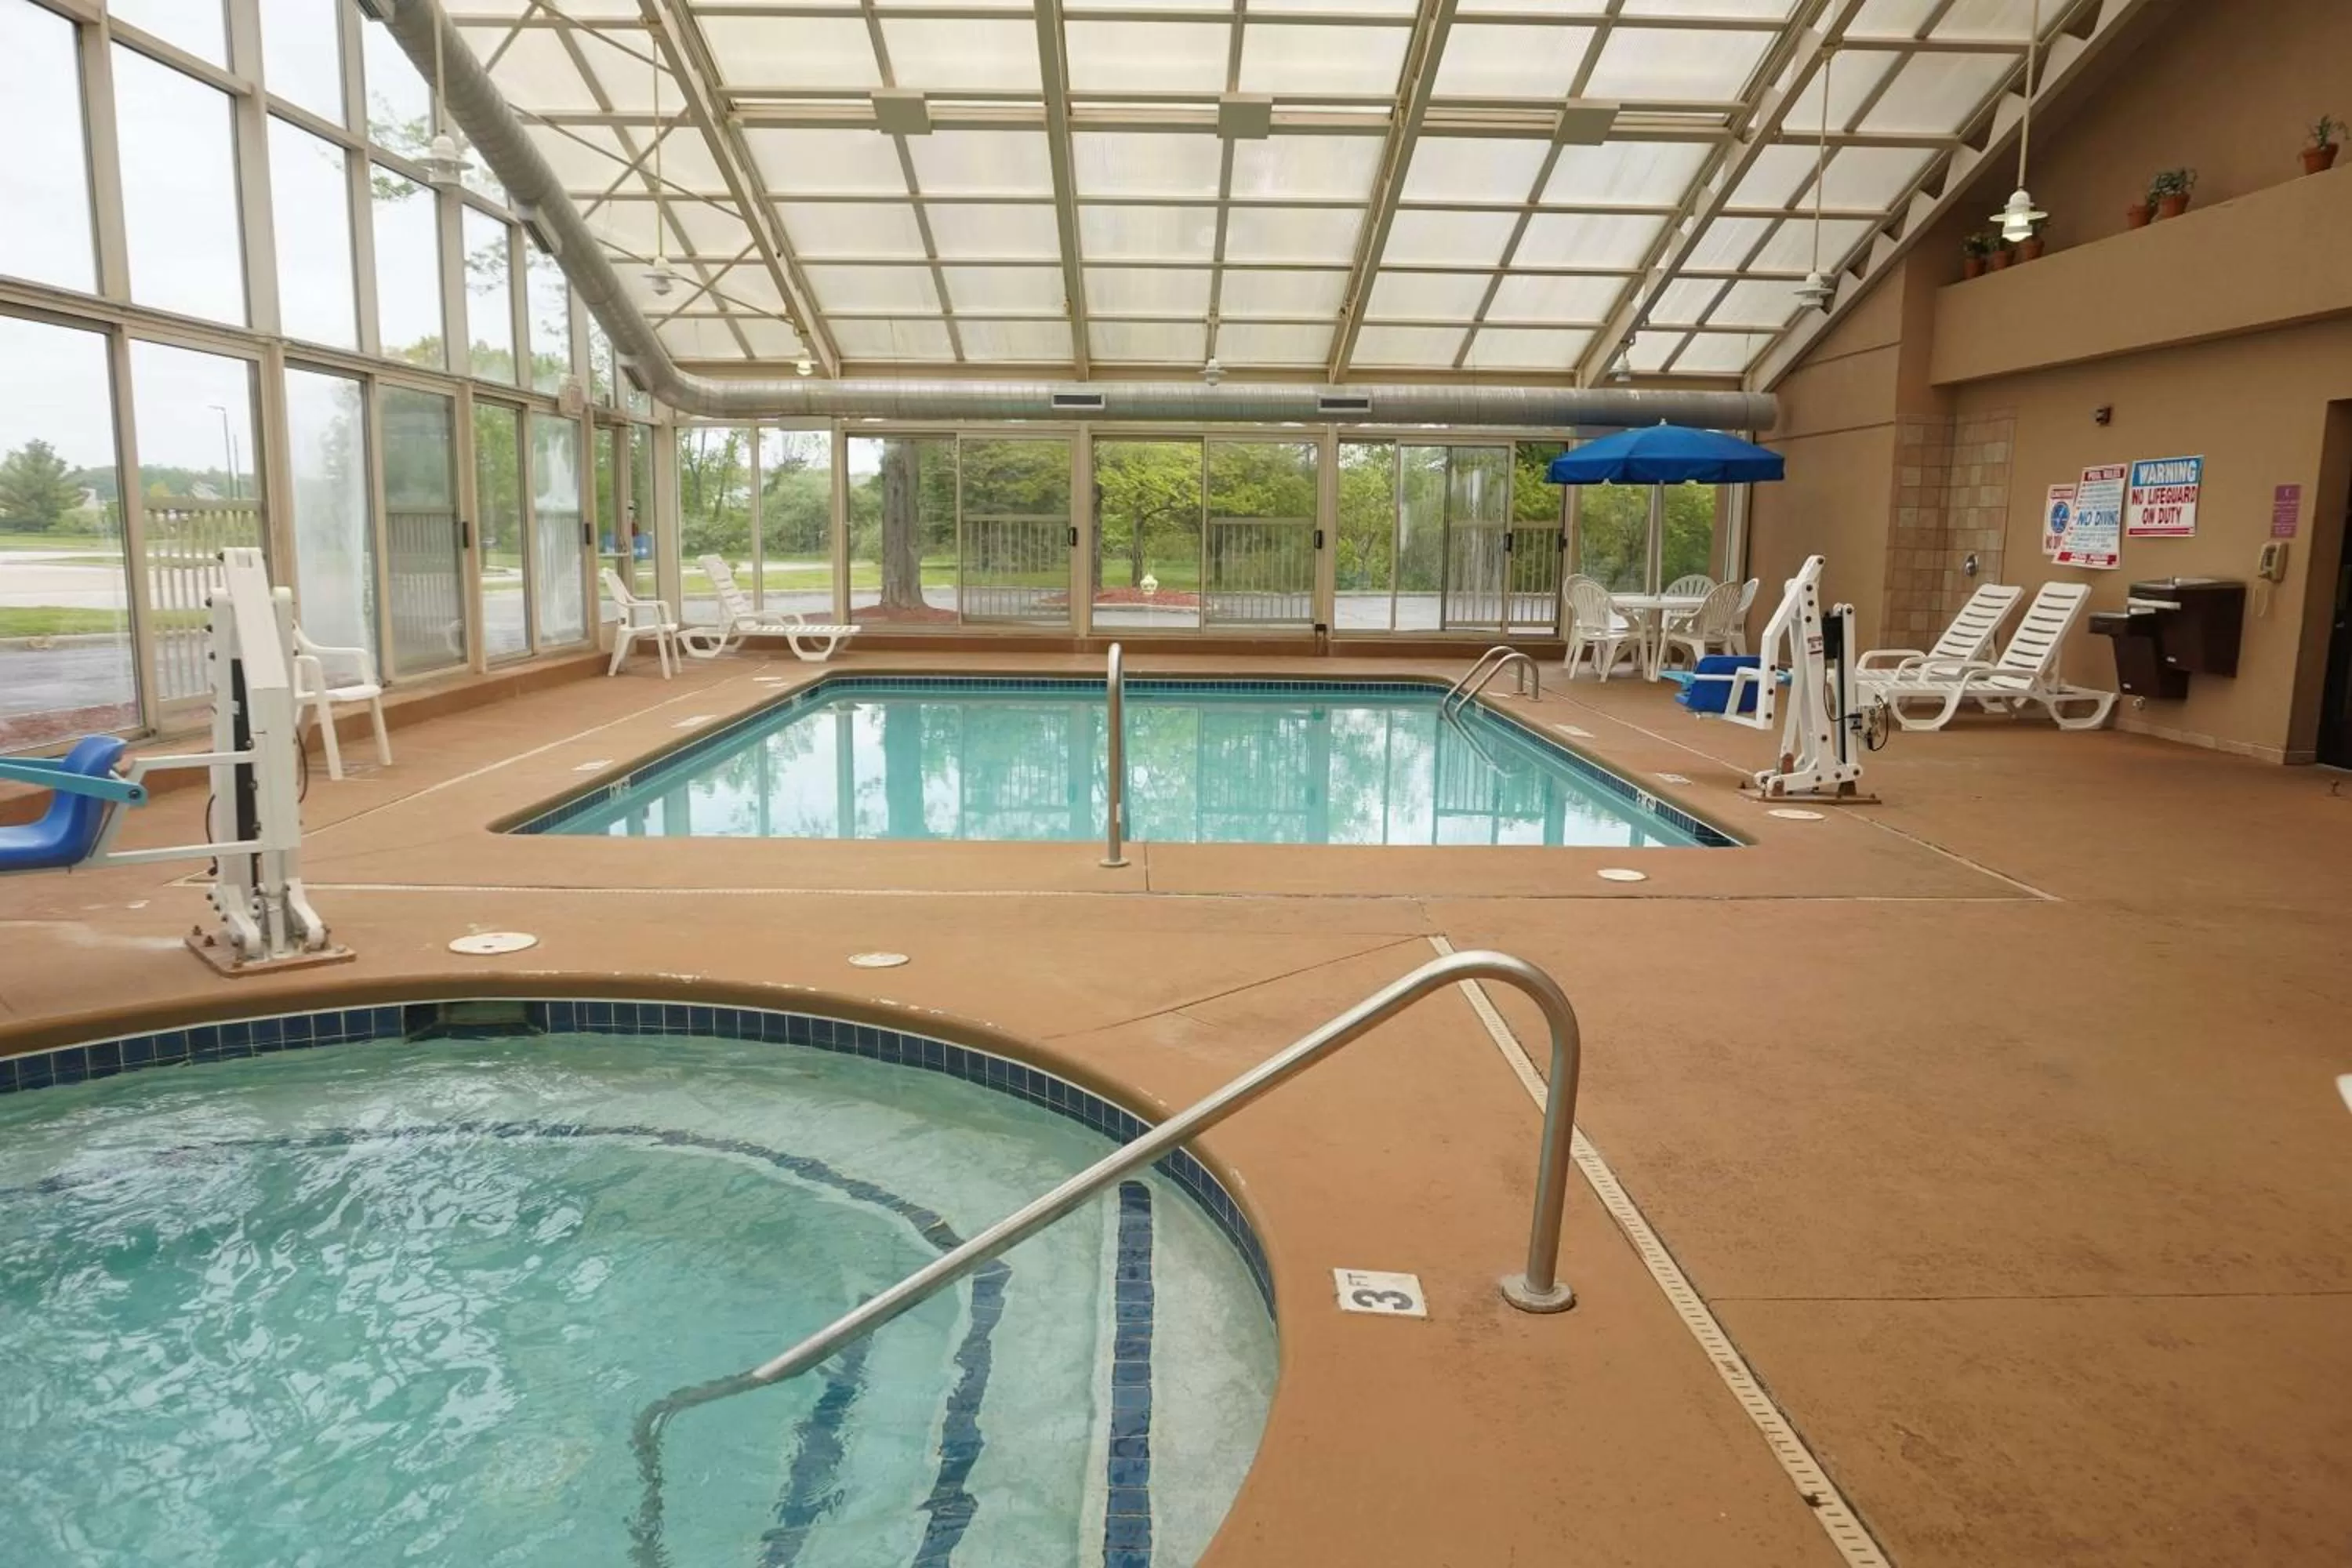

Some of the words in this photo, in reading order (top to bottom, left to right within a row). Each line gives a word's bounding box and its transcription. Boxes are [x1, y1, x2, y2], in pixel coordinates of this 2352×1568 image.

[2138, 460, 2198, 484] WARNING
[2132, 488, 2144, 504] NO
[2148, 485, 2196, 504] LIFEGUARD
[2076, 511, 2092, 525] NO
[2143, 507, 2155, 524] ON
[2158, 506, 2183, 524] DUTY
[1347, 1272, 1368, 1287] FT
[1352, 1289, 1413, 1310] 3
